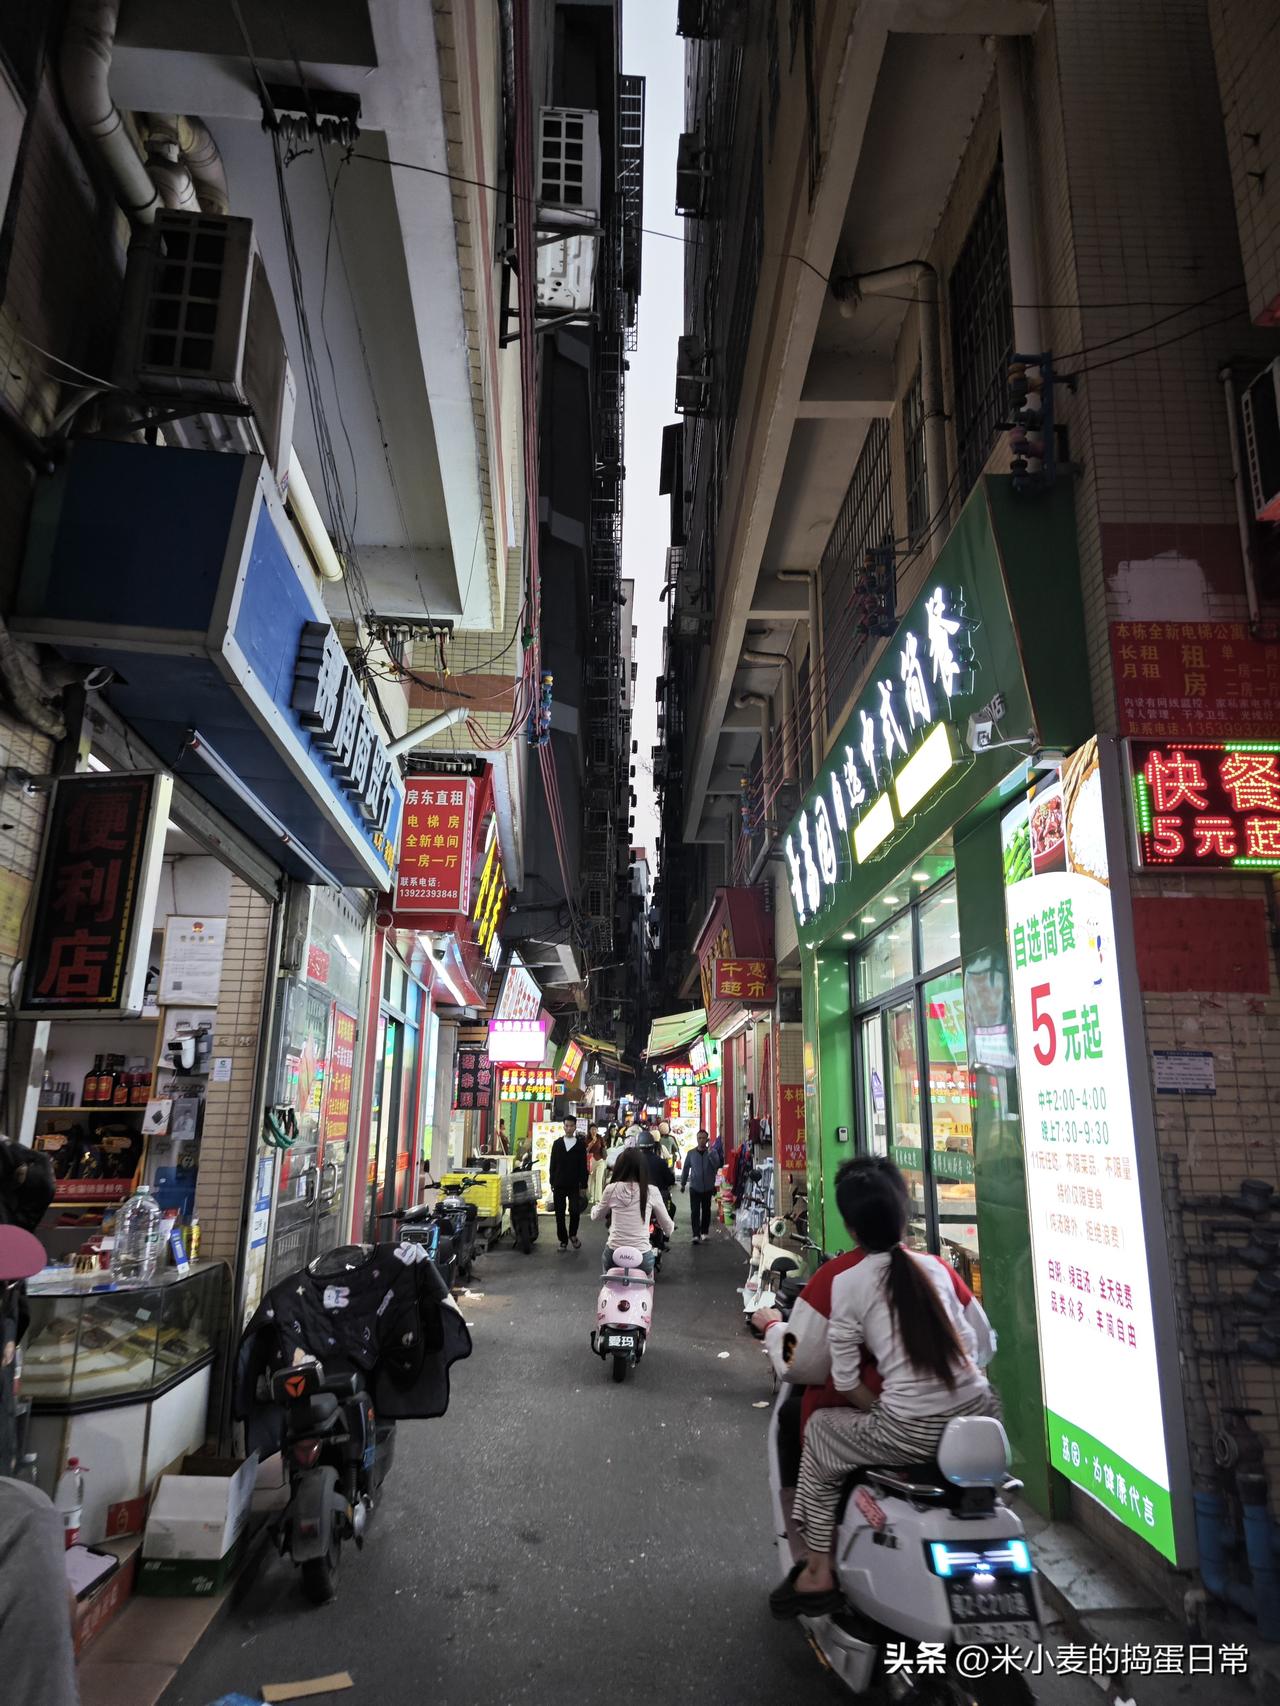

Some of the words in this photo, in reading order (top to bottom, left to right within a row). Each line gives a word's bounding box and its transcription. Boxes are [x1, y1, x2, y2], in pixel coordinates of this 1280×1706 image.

[1120, 644, 1160, 660] 长租
[1121, 663, 1161, 680] 月租
[1145, 751, 1280, 812] 快餐
[405, 789, 465, 807] 房东直租
[407, 814, 461, 829] 电梯房
[405, 834, 460, 849] 全新单间
[1152, 816, 1280, 858] 5元起
[403, 853, 459, 869] 一房一厅
[36, 792, 134, 998] 便利店
[399, 889, 459, 899] 13922393848
[1013, 898, 1077, 971] 自选简餐
[720, 980, 767, 998] 超市
[1030, 982, 1104, 1066] 5元起
[1038, 1086, 1107, 1112] 中午2:00-4:00
[1041, 1120, 1110, 1145] 晚上7:30-9:30
[619, 1253, 635, 1261] AIMA
